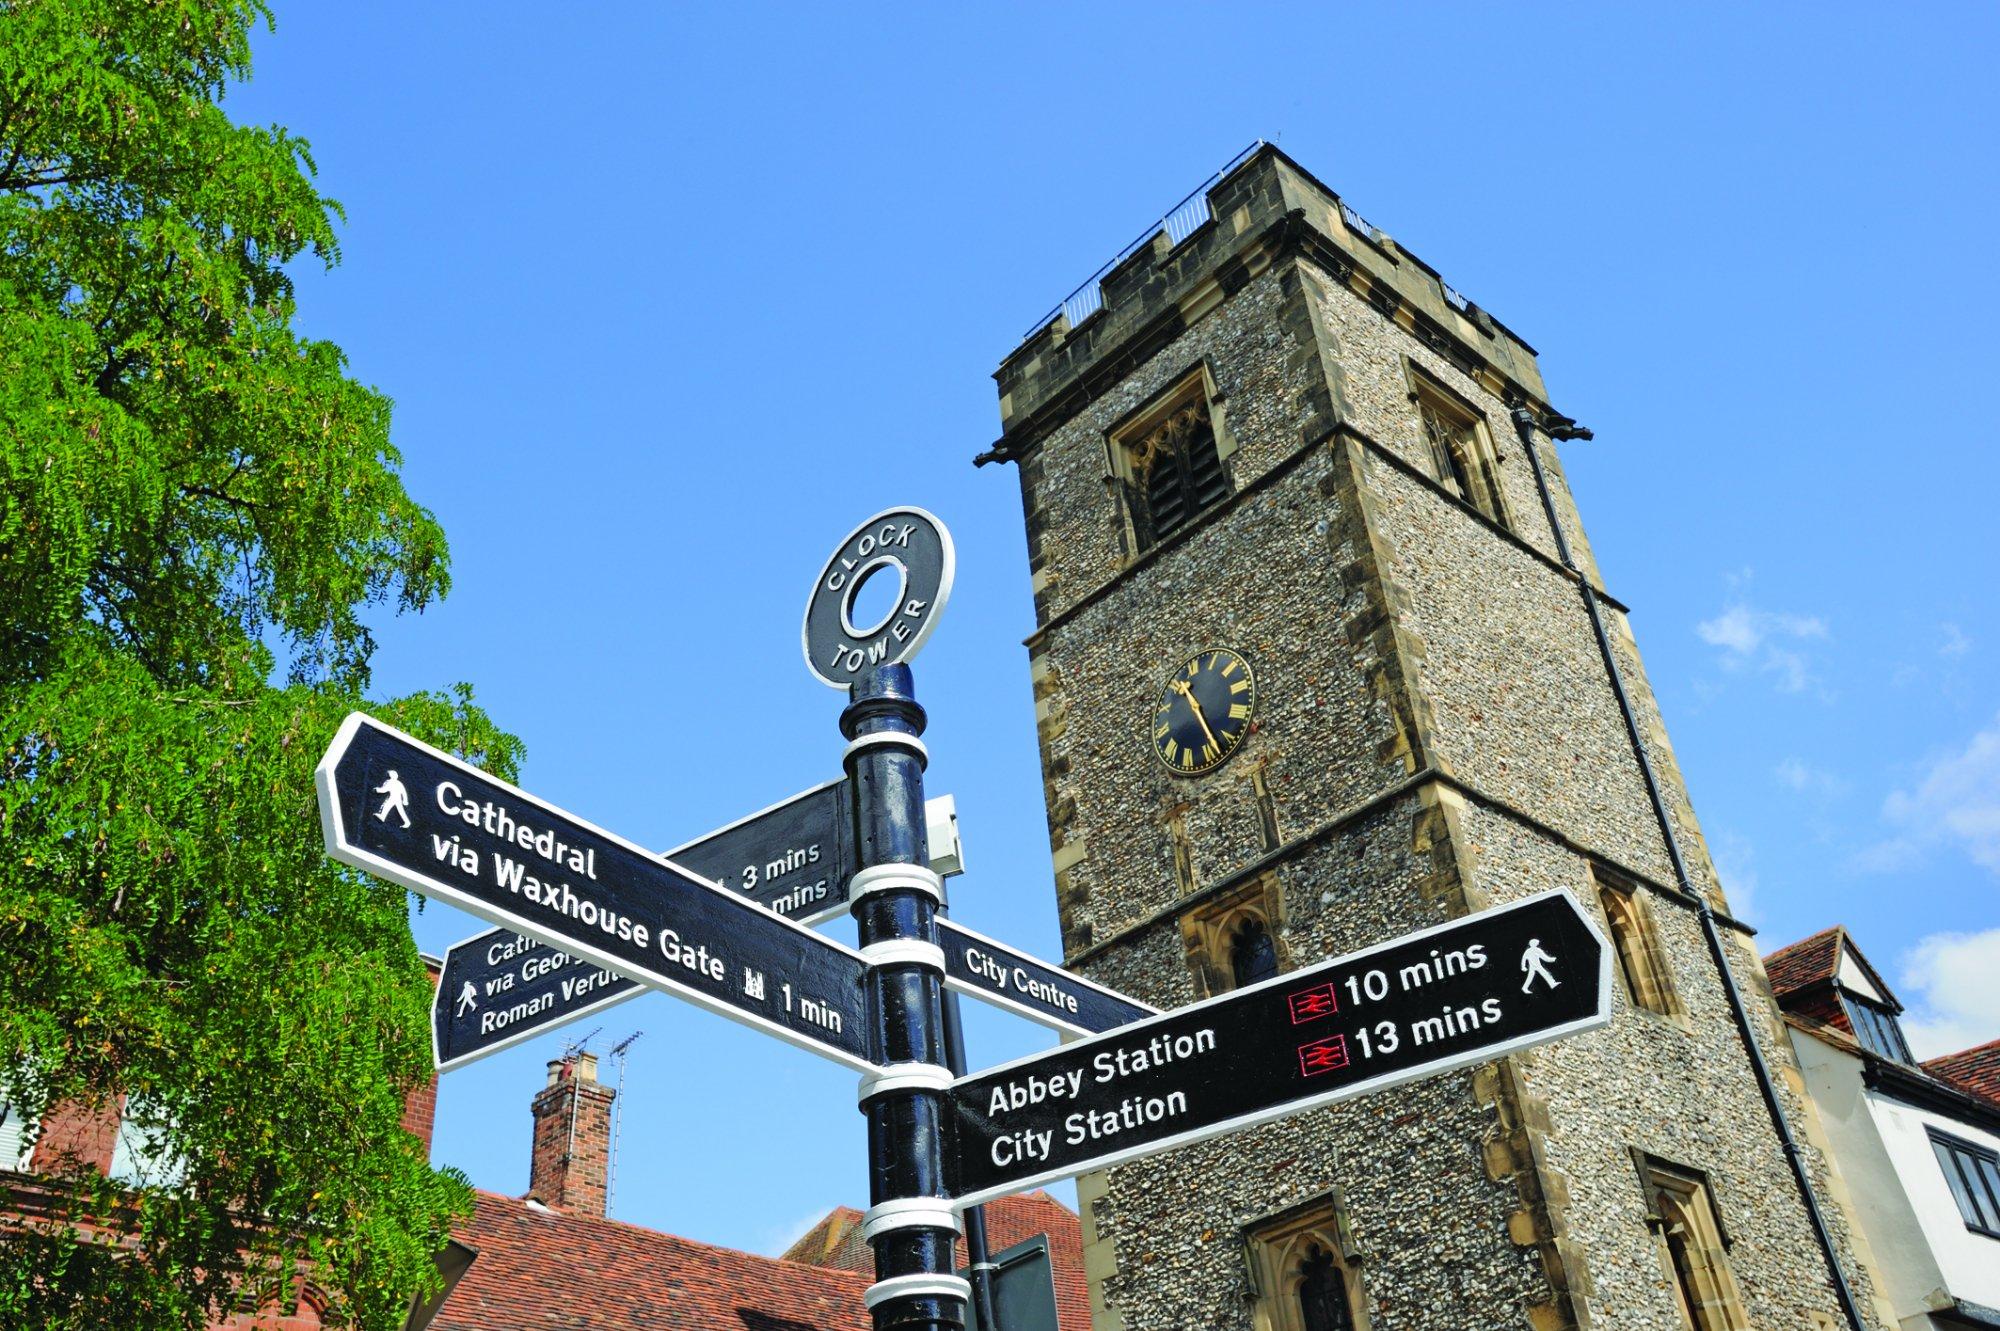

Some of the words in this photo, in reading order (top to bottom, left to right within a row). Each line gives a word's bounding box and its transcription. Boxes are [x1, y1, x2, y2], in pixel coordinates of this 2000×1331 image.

[828, 524, 915, 591] CLOCK
[831, 599, 926, 672] TOWER
[437, 782, 596, 879] Cathedral
[743, 865, 758, 889] 3
[766, 843, 820, 881] mins
[772, 879, 827, 917] mins
[433, 834, 478, 876] via
[495, 853, 648, 947] Waxhouse
[660, 929, 724, 980] Gate
[783, 984, 791, 1011] 1
[801, 998, 841, 1033] min
[482, 992, 554, 1034] Roman
[486, 973, 515, 996] via
[967, 948, 1007, 988] City
[1014, 968, 1077, 1012] Centre
[989, 1069, 1083, 1116] Abbey
[1095, 1029, 1214, 1082] Station
[1346, 970, 1388, 1005] 10
[1400, 945, 1487, 990] mins
[992, 1130, 1052, 1166] City
[1066, 1092, 1186, 1144] Station
[1356, 1021, 1399, 1058] 13
[1412, 999, 1501, 1045] mins
